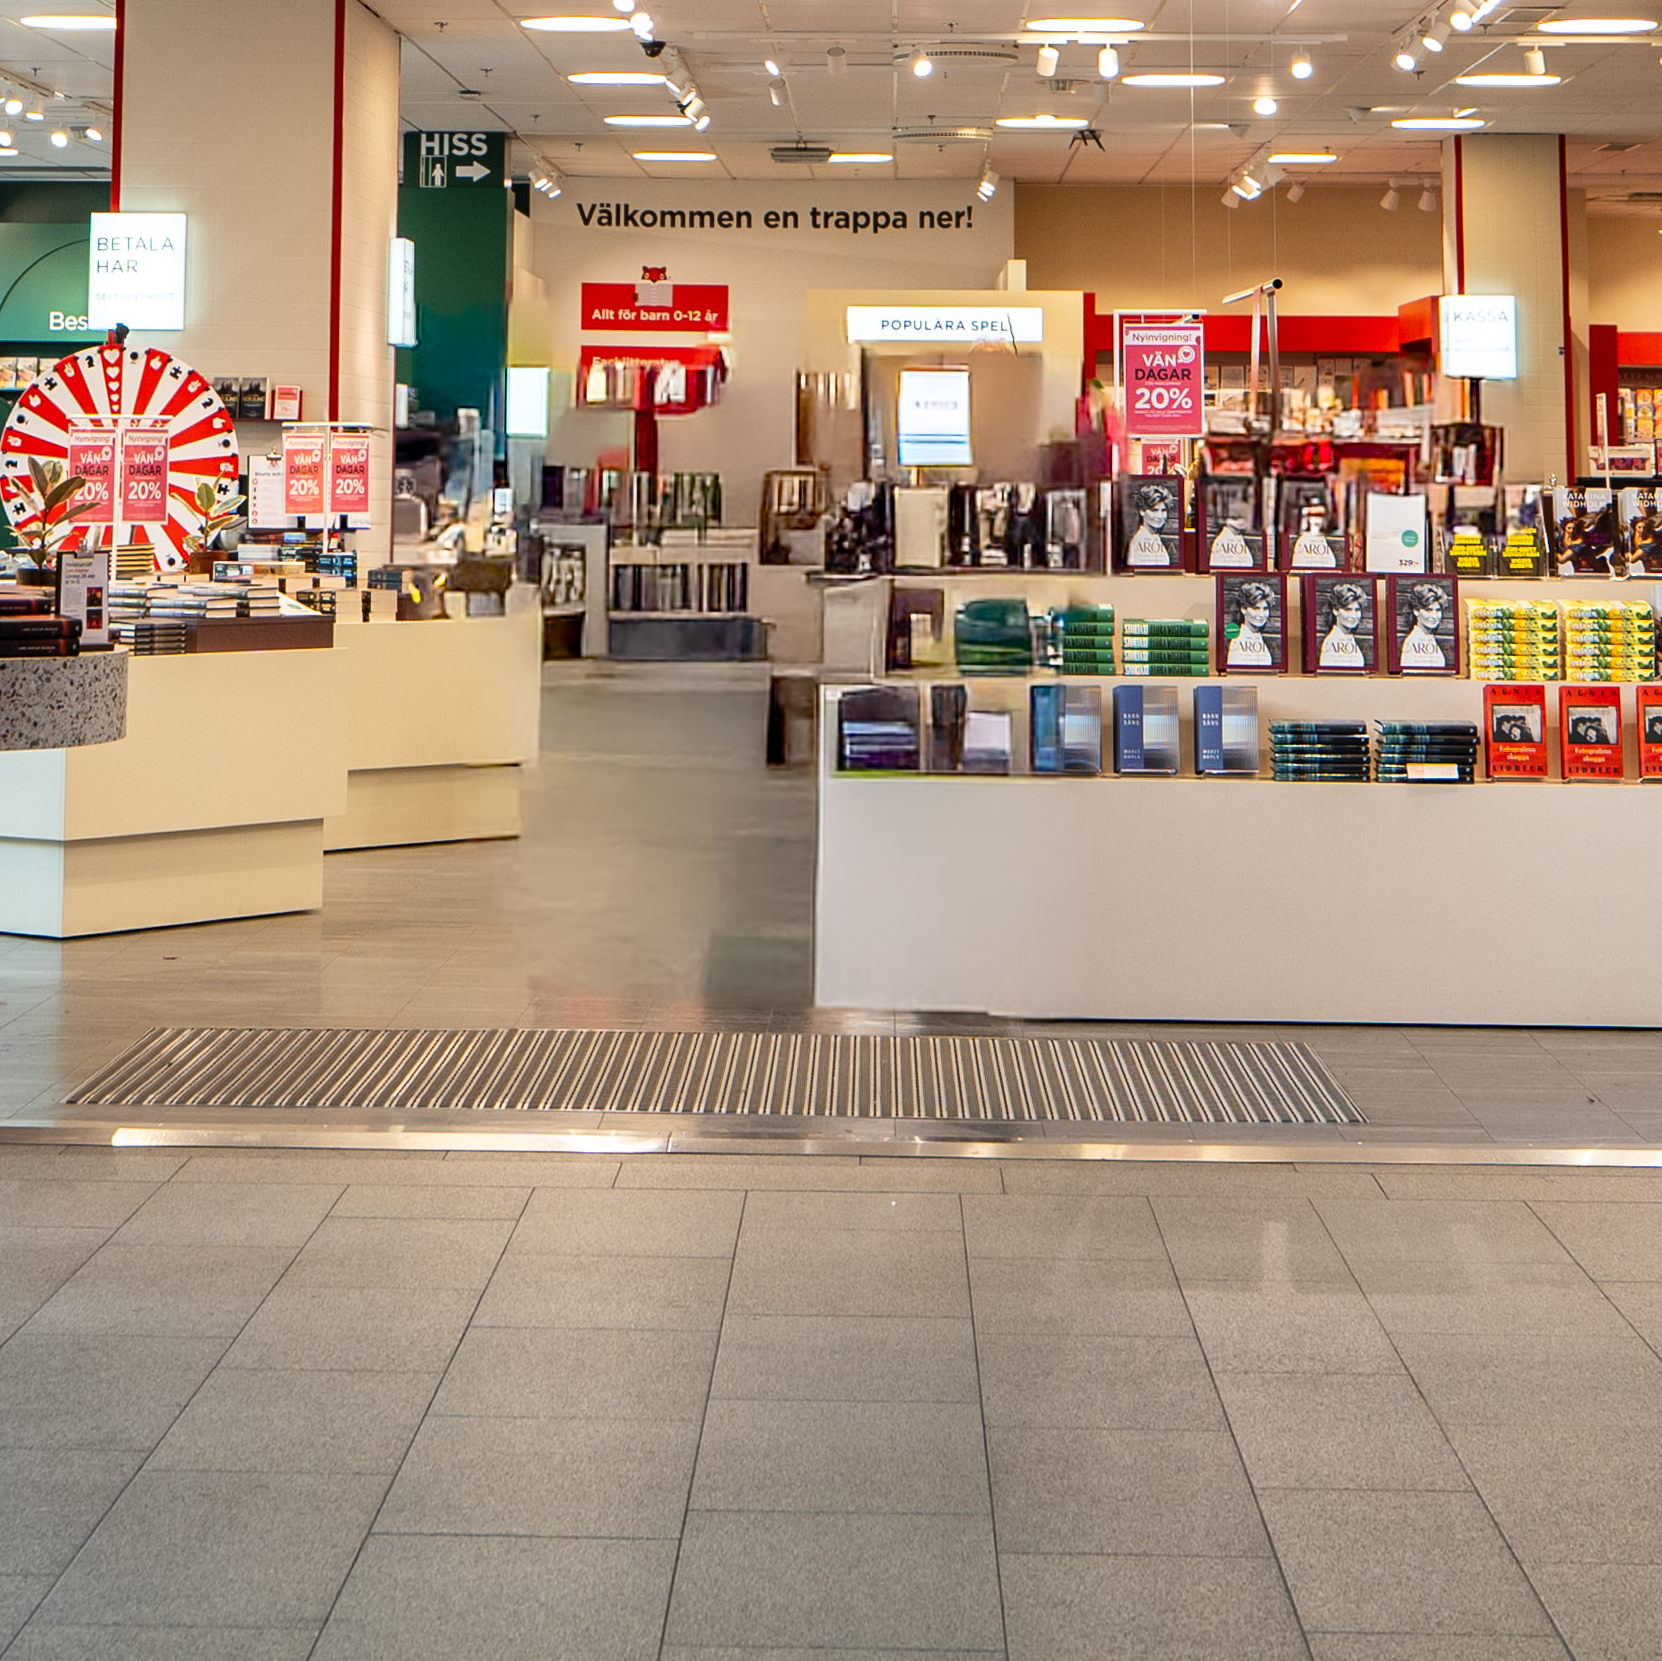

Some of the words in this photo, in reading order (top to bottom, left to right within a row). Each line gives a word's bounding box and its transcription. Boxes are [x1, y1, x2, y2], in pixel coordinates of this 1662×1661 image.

[420, 133, 488, 156] HISS
[576, 202, 753, 229] Välkommen
[763, 210, 799, 229] en
[810, 206, 908, 234] trappa
[918, 205, 973, 229] ner!
[97, 236, 175, 252] BETALA
[96, 256, 139, 273] HÄR
[49, 310, 88, 331] Bes
[591, 309, 616, 321] Allt
[618, 308, 638, 321] för
[640, 309, 670, 321] barn
[673, 309, 701, 322] 0-12
[704, 308, 719, 322] år
[1453, 311, 1509, 322] KASSA
[881, 317, 966, 331] POPULÄRA
[971, 320, 1008, 332] SPEL
[1132, 333, 1192, 343] Nyinvigning!
[1141, 351, 1177, 367] VÄN
[1134, 368, 1192, 381] DAGAR
[1134, 387, 1193, 410] 20%
[80, 450, 101, 464] VÄN
[133, 450, 154, 464] VÄN
[294, 452, 312, 465] VÄN
[340, 452, 358, 464] VÄN
[75, 465, 109, 475] DAGAR
[128, 465, 162, 475] DAGAR
[289, 465, 319, 474] DAGAR
[335, 465, 365, 474] DAGAR
[74, 482, 109, 501] 20%
[128, 482, 162, 501] 20%
[289, 479, 320, 496] 20%
[335, 479, 365, 494] 20%
[1562, 493, 1606, 501] KATARINA
[1492, 764, 1545, 772] LIDBECK
